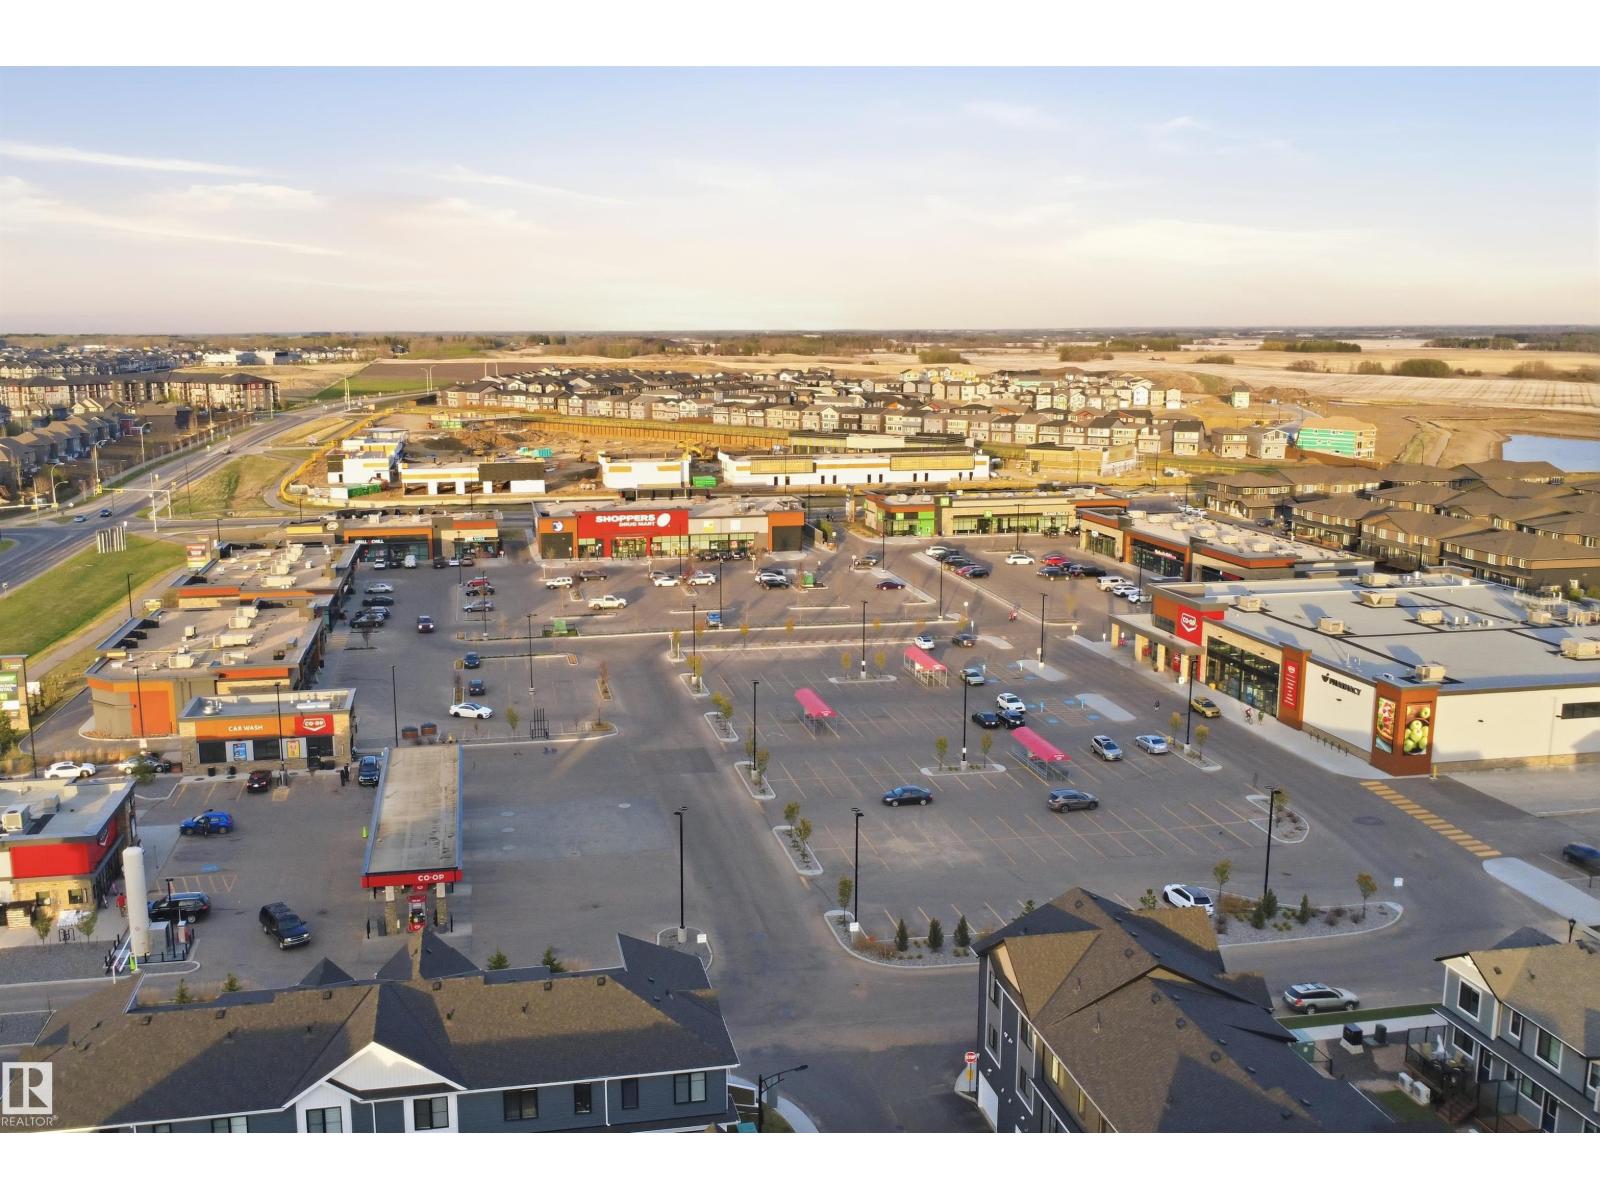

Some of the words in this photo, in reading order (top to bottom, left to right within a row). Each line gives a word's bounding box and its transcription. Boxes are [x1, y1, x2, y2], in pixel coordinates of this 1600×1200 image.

[595, 514, 656, 523] SHOPPERS
[1329, 678, 1361, 696] PHARMACY
[418, 873, 445, 882] CO-OP
